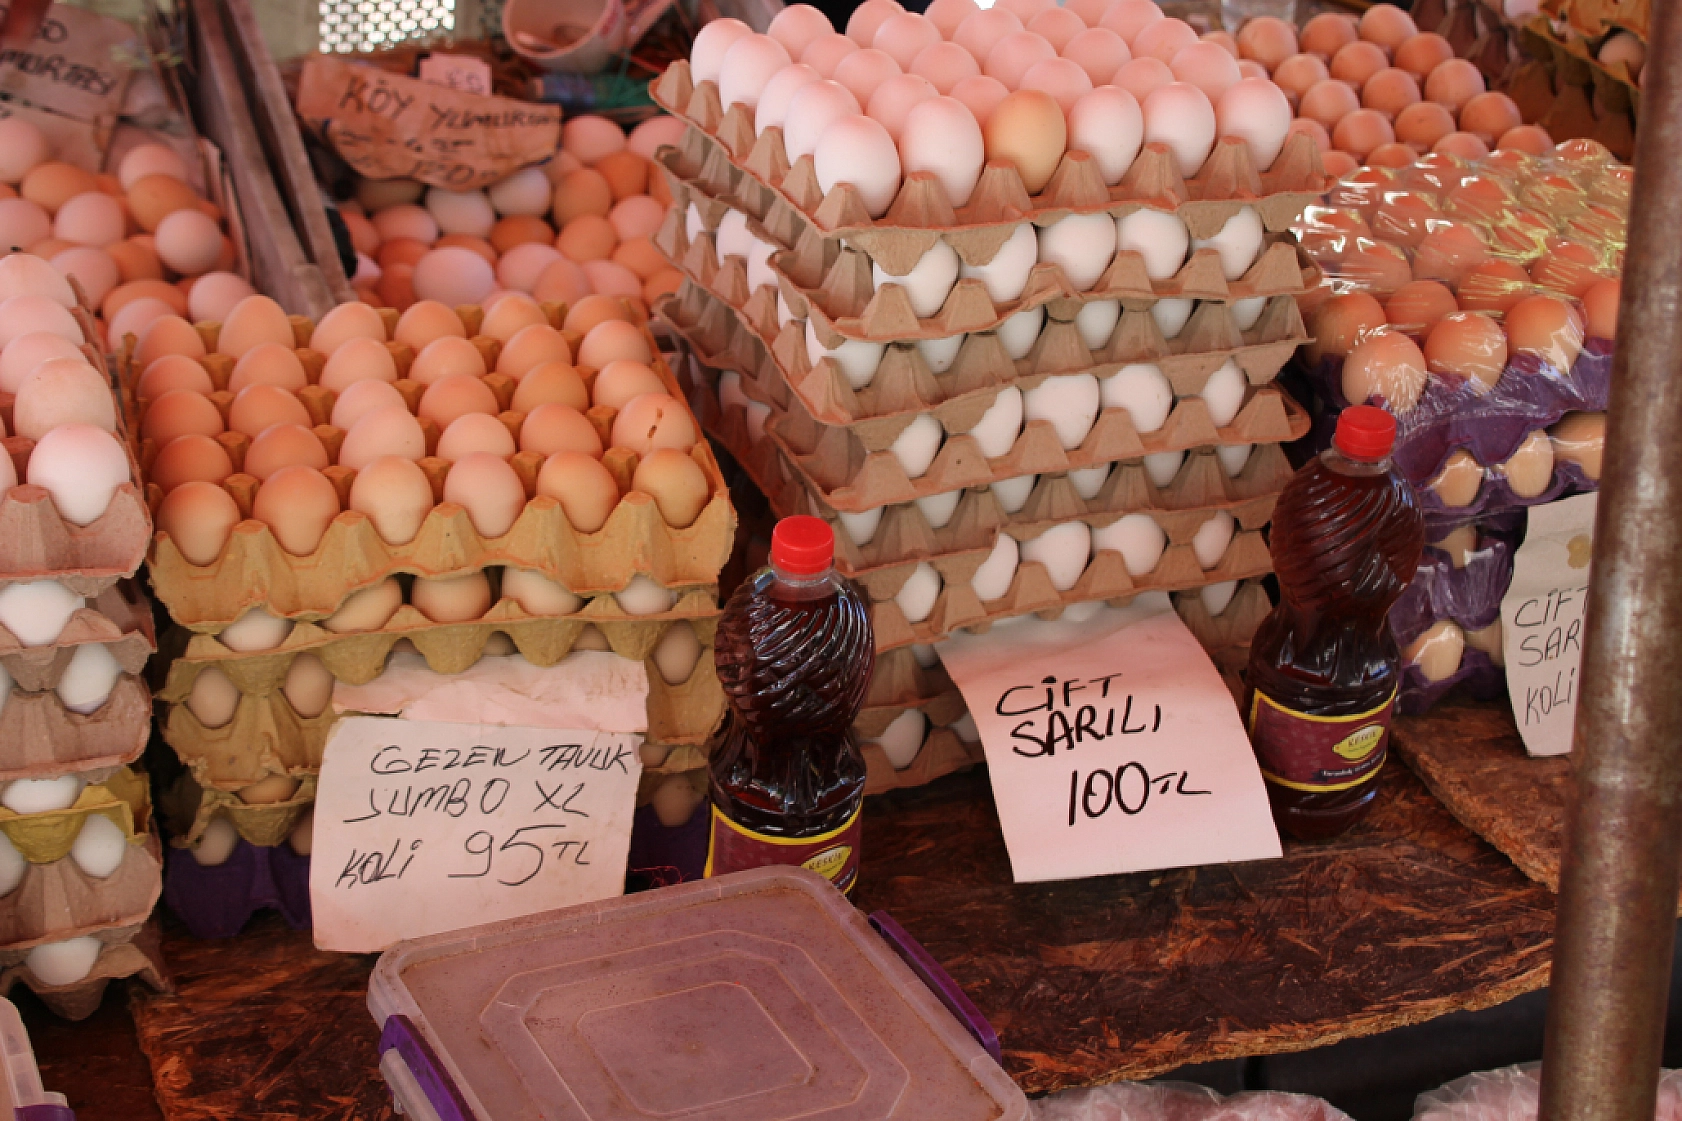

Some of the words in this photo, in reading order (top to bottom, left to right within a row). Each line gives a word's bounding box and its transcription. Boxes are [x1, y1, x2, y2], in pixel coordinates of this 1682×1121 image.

[1518, 618, 1581, 668] SAR
[370, 745, 531, 775] GEZEN
[538, 743, 633, 774] TAVUK
[533, 781, 590, 818] XL
